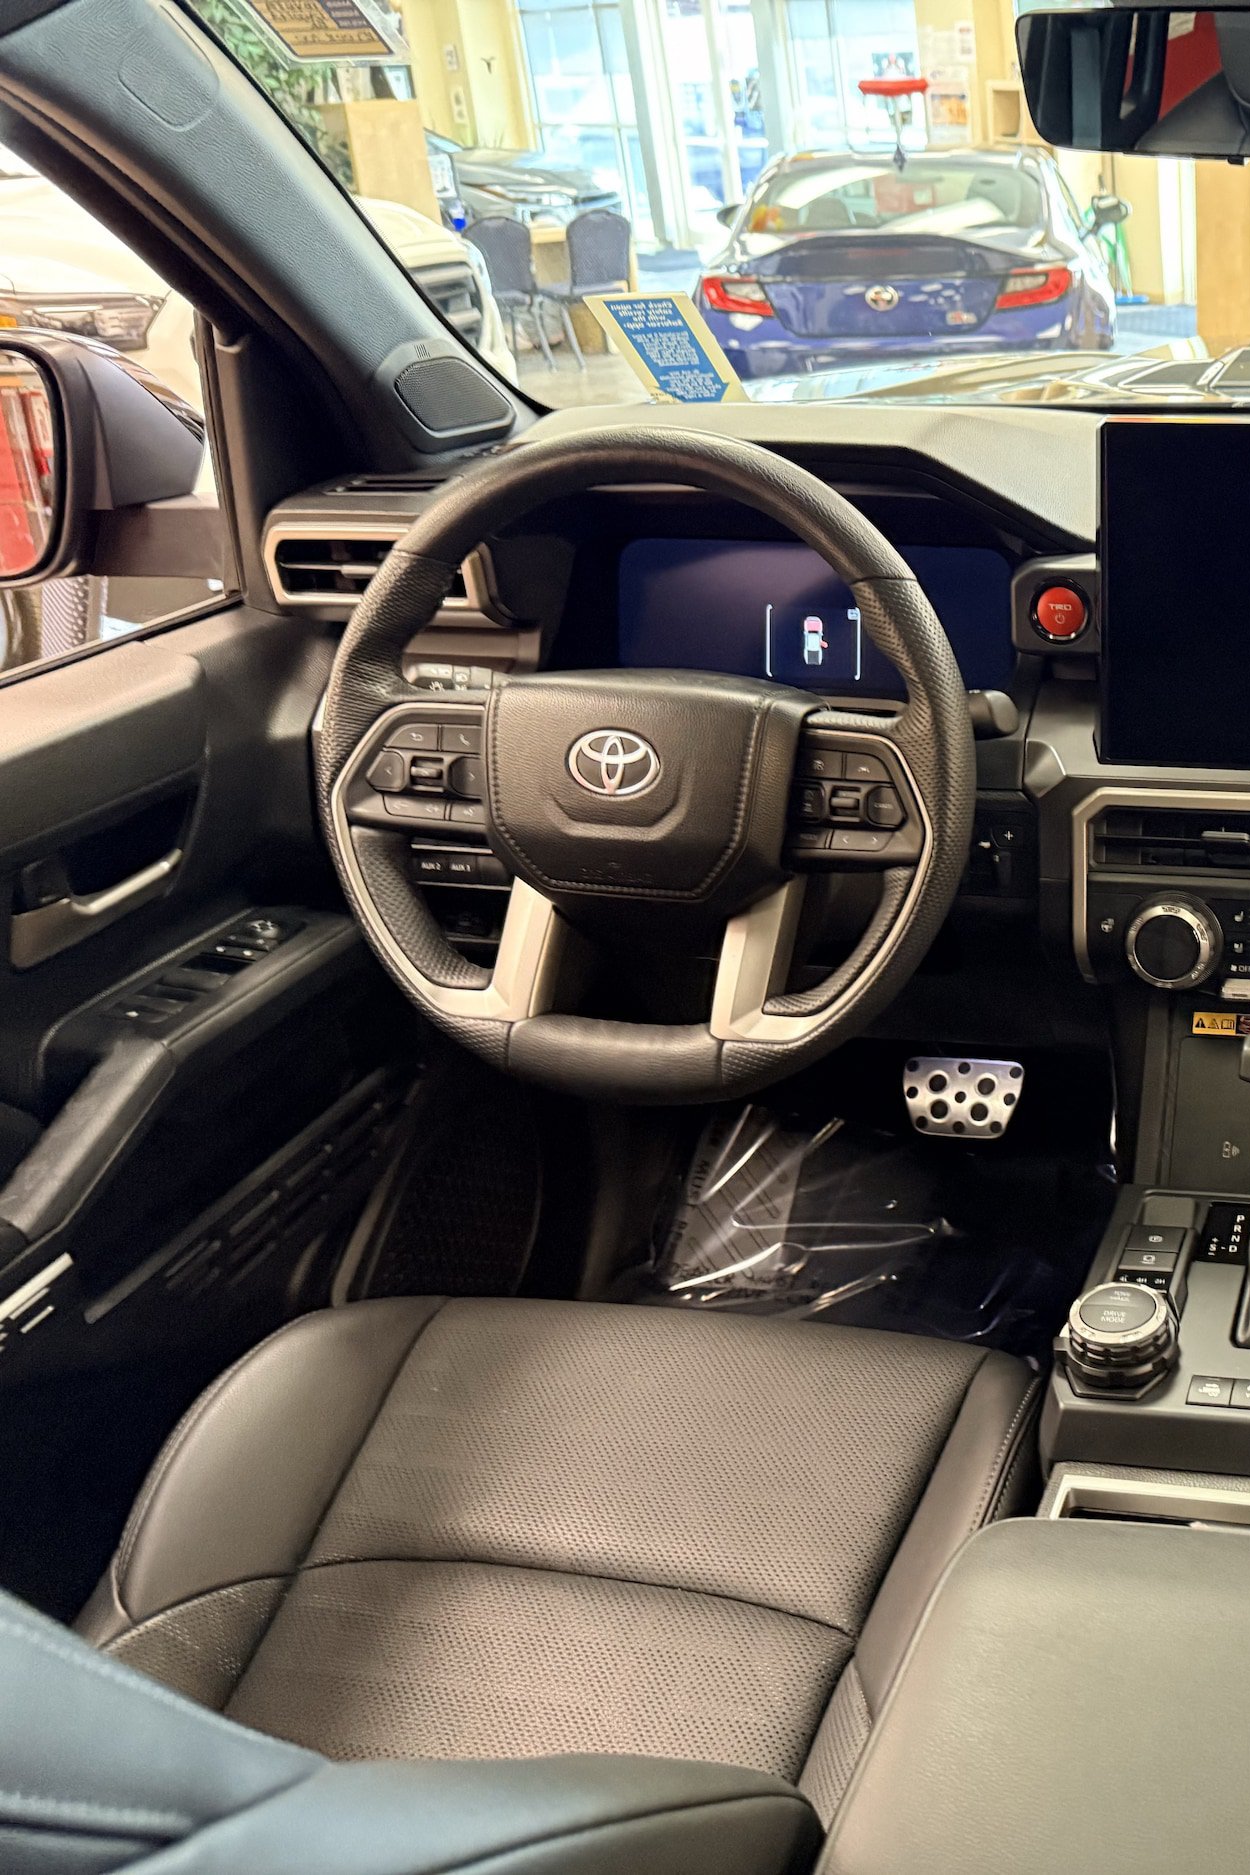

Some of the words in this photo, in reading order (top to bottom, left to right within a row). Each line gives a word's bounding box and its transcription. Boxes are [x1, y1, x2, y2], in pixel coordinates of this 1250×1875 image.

[1048, 603, 1072, 611] TRD
[1236, 1214, 1245, 1223] P
[1233, 1224, 1242, 1233] R
[1230, 1234, 1240, 1242] N
[1209, 1243, 1217, 1251] S
[1228, 1244, 1238, 1253] D
[1103, 1310, 1127, 1318] DRIVE
[1100, 1316, 1125, 1324] MODE
